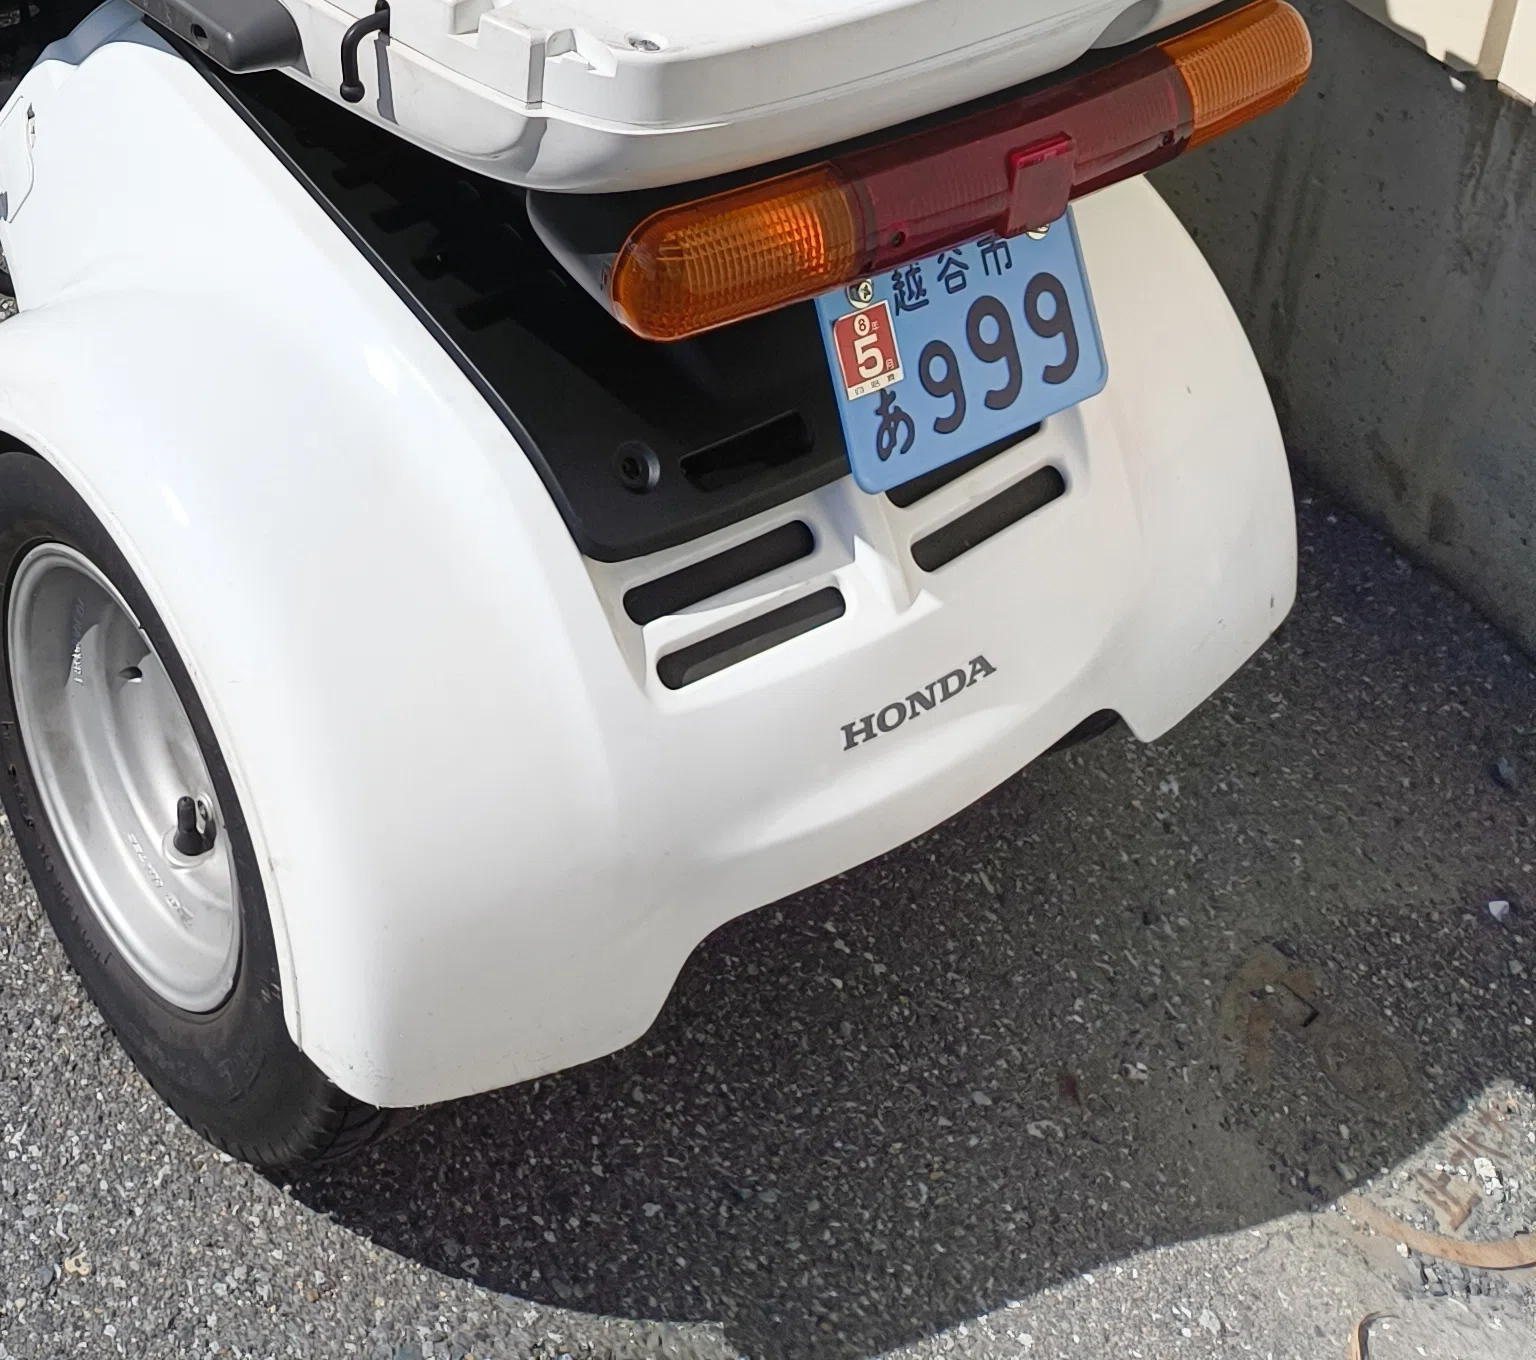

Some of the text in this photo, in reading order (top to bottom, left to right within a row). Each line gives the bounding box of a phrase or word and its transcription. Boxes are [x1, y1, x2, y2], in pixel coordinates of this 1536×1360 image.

[891, 236, 1013, 316] 越谷市
[875, 272, 1080, 462] あ 999
[840, 654, 997, 751] HONDA
